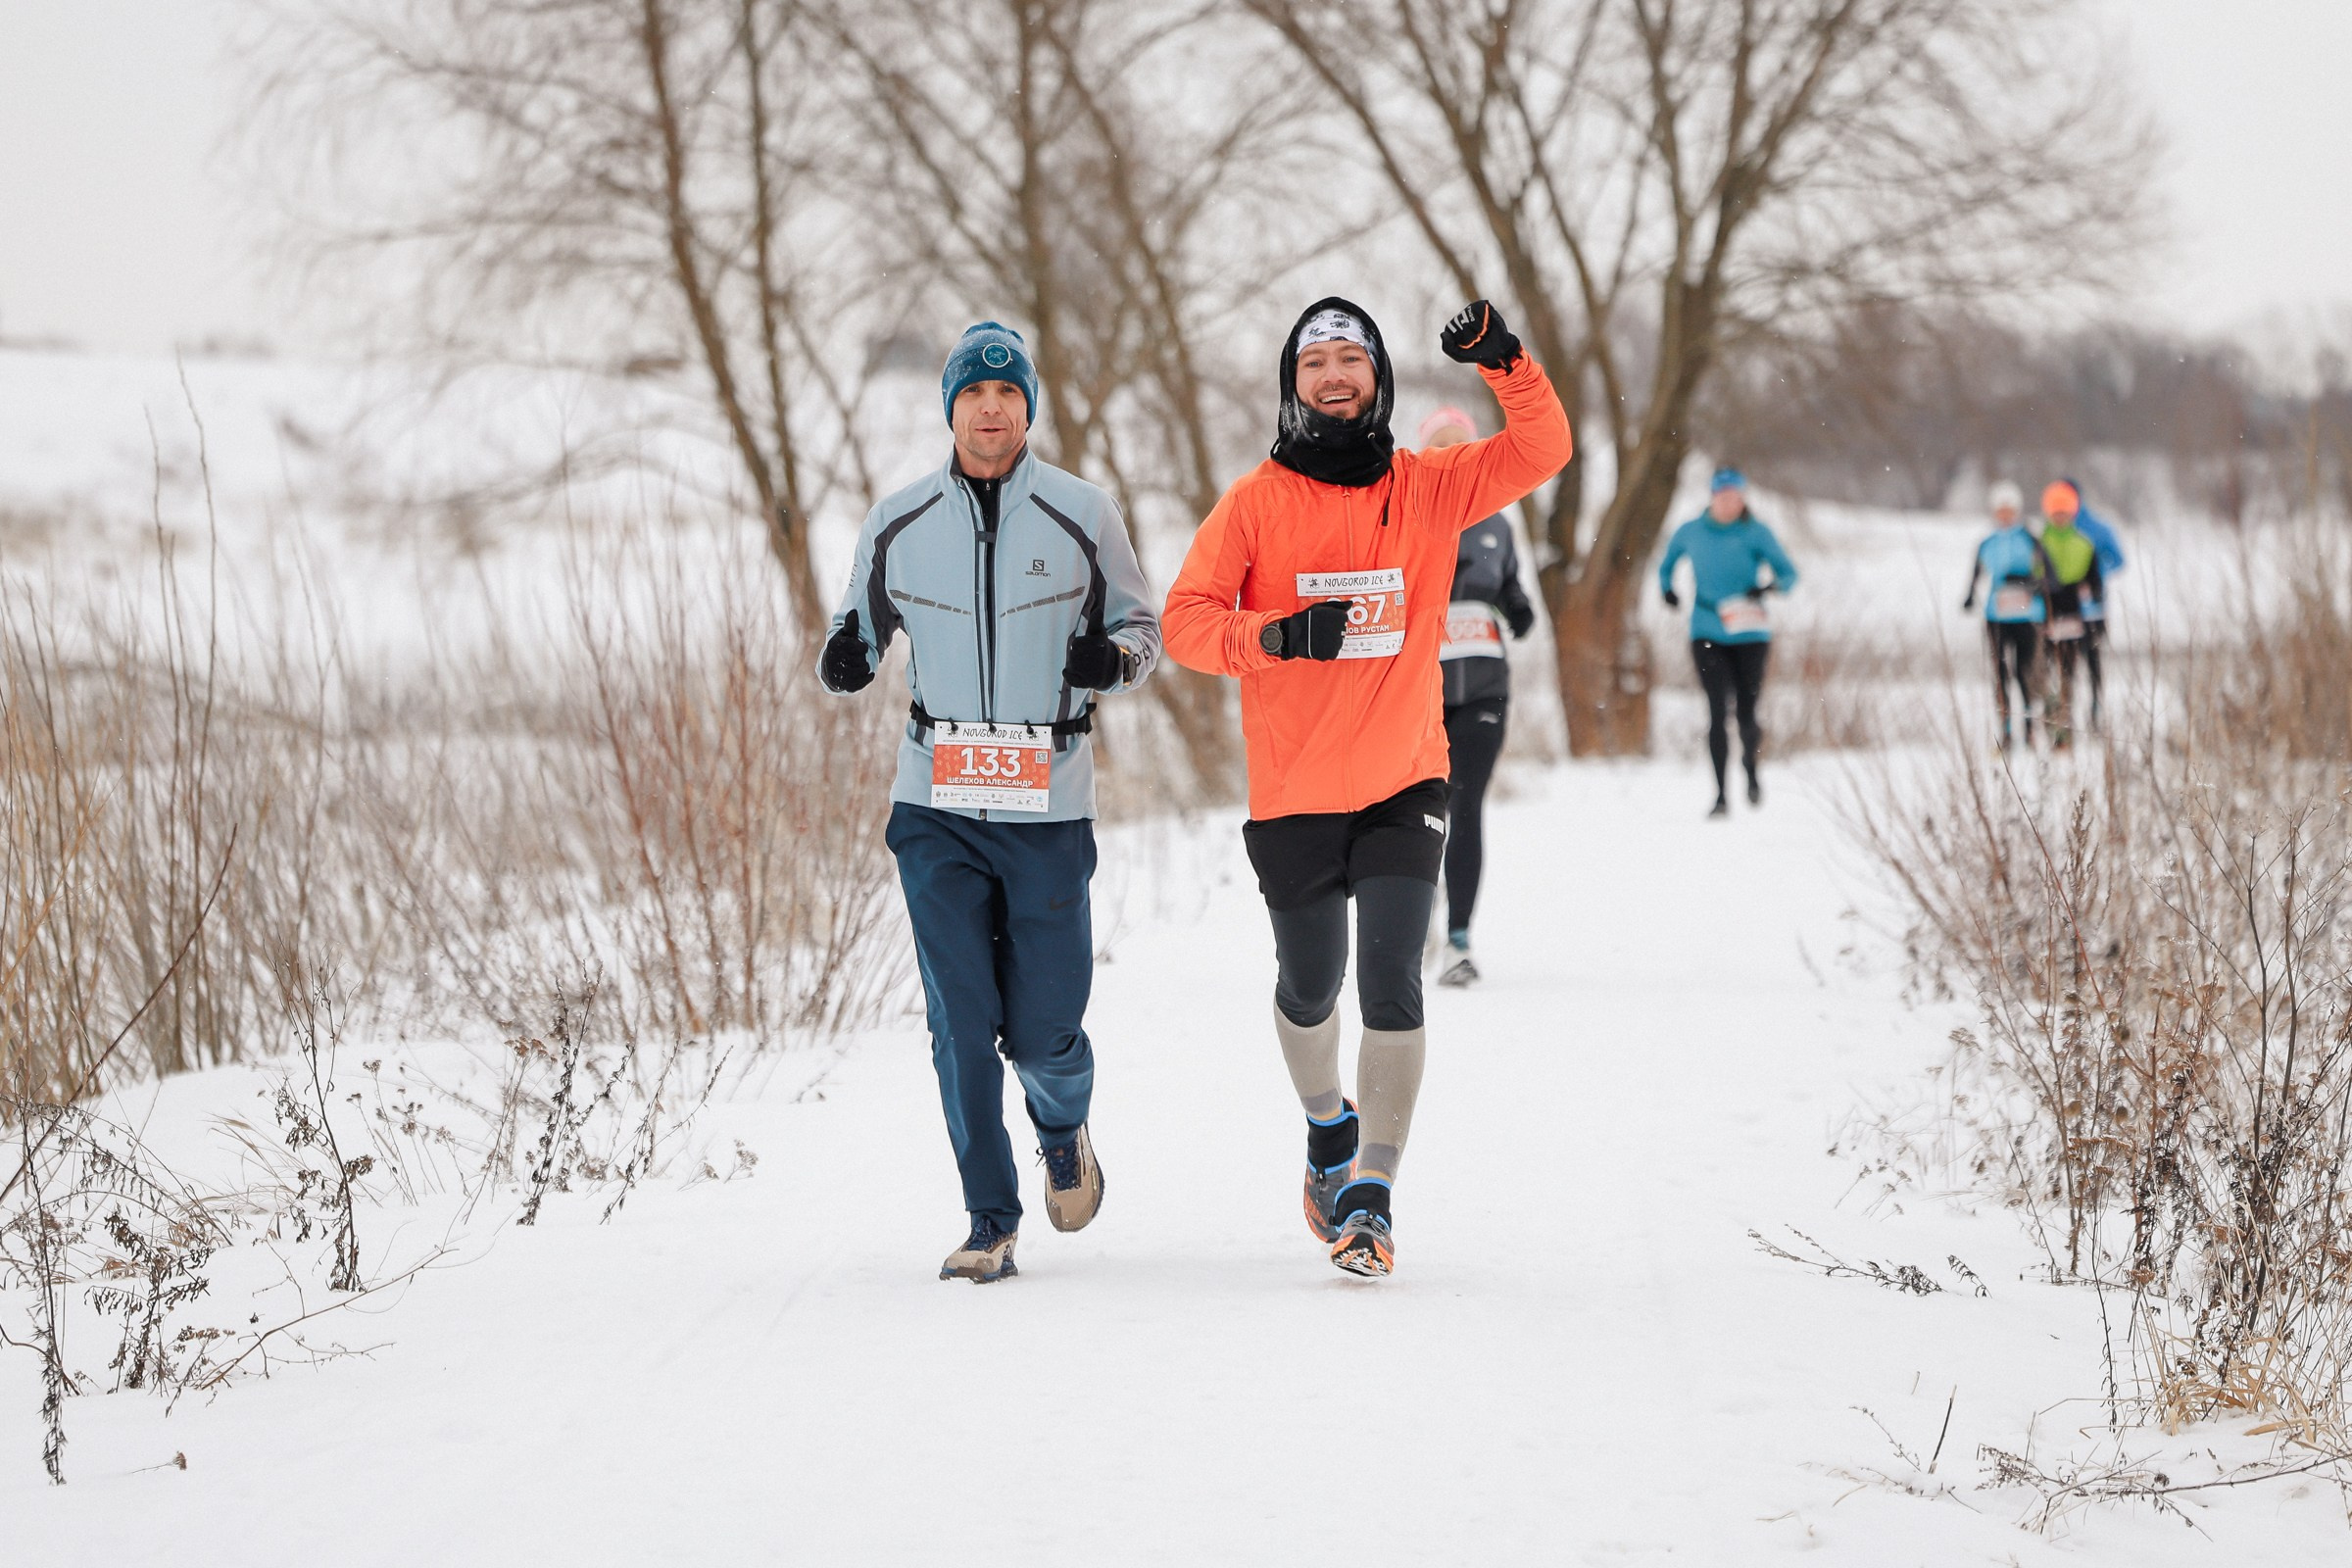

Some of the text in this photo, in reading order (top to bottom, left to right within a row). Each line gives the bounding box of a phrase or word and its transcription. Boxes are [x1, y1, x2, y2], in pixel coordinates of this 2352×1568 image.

[1324, 575, 1383, 587] NOVGOROD ICE
[1326, 594, 1387, 625] 67
[1361, 624, 1390, 634] РУСТАМ
[1008, 730, 1022, 741] ICE
[959, 747, 1021, 777] 133
[986, 778, 1034, 788] АЛЕКСАНДР
